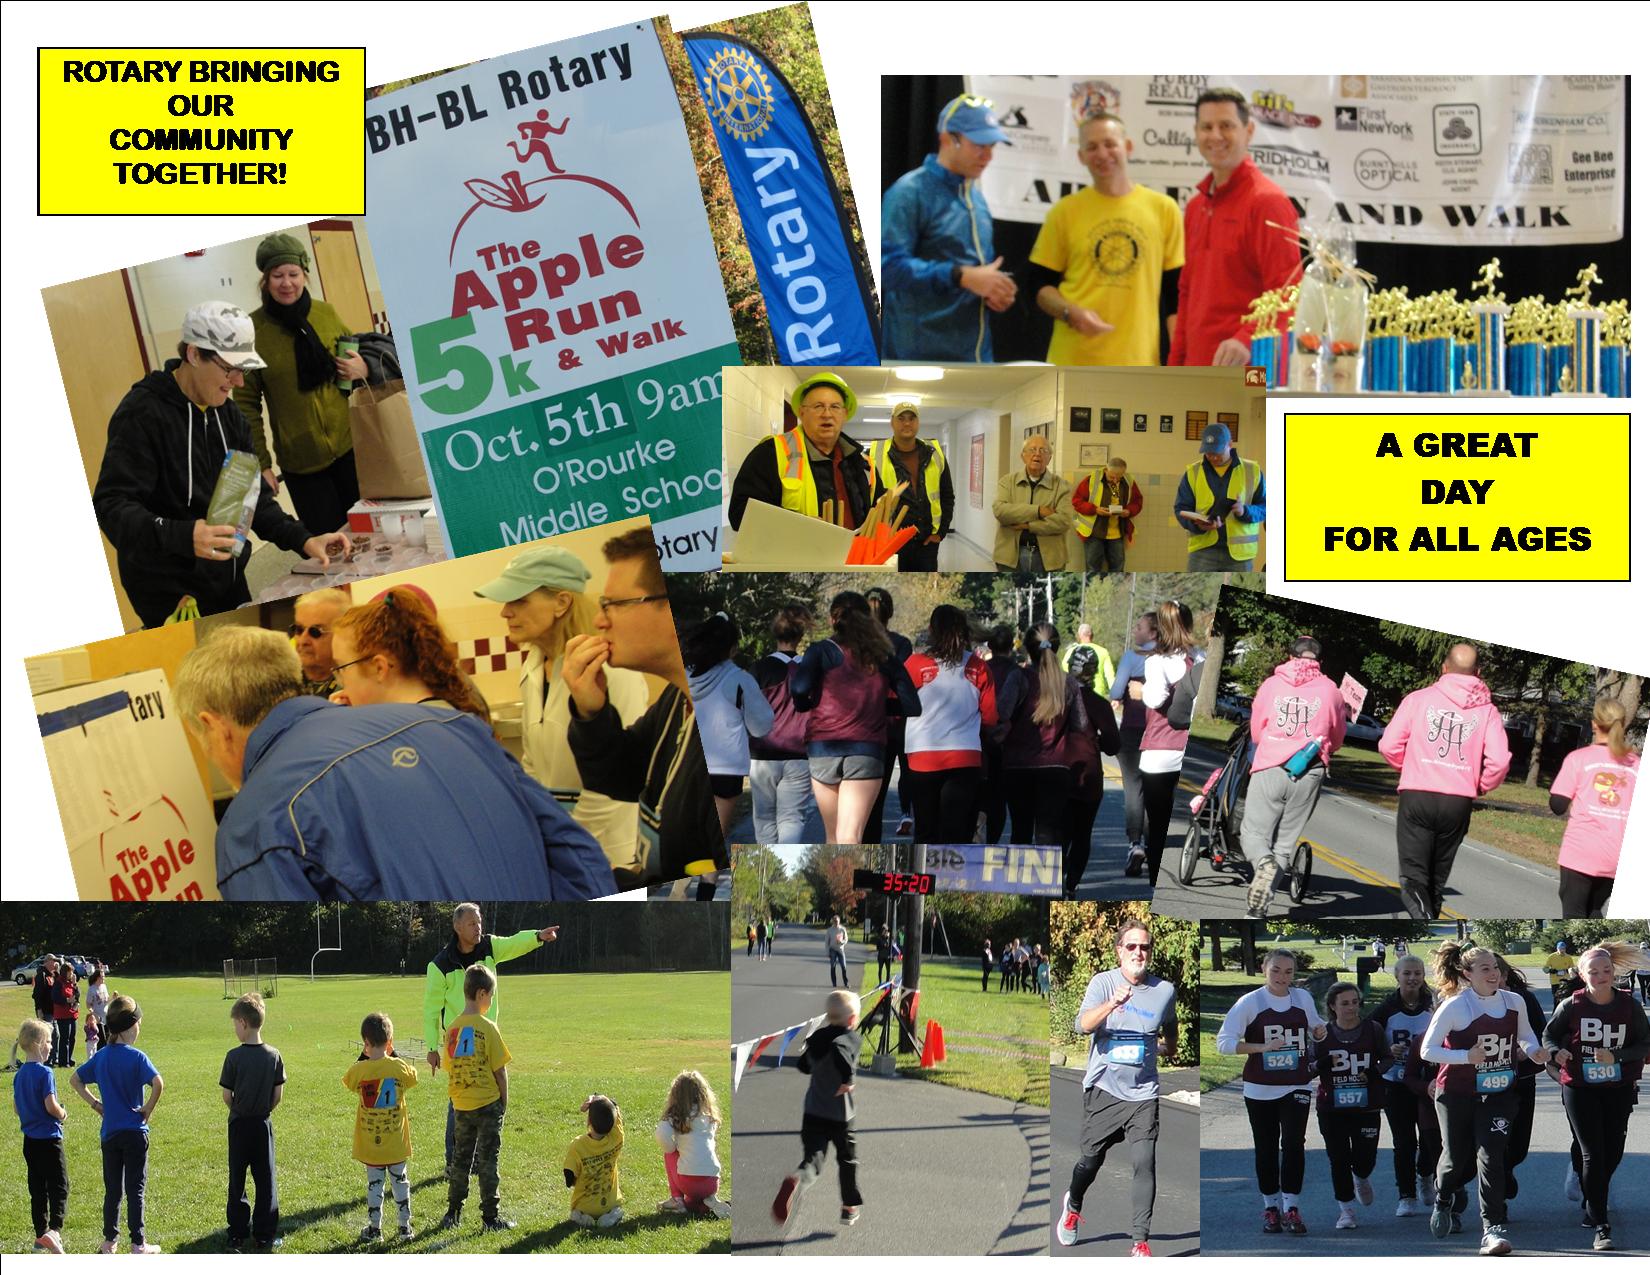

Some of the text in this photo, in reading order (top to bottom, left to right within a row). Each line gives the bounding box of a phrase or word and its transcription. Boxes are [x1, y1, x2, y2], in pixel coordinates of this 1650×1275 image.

[366, 43, 632, 154] BH-BL Rotary
[1359, 107, 1387, 121] First
[1254, 150, 1330, 174] RIDHOLM
[1360, 169, 1421, 182] OPTICAL
[1327, 202, 1423, 226] AND
[1441, 204, 1571, 228] WALK
[476, 240, 541, 271] The
[744, 147, 841, 363] Rotary
[451, 233, 645, 320] Apple
[504, 290, 643, 352] Run
[558, 318, 687, 371] & Walk
[445, 425, 541, 472] Oct.
[544, 392, 629, 447] 5th
[533, 439, 676, 494] O'Rourke
[499, 468, 722, 548] Middle Schoo
[127, 690, 167, 722] tary
[109, 838, 196, 901] Apple
[116, 845, 149, 873] The
[982, 846, 1063, 886] FIN
[463, 1038, 469, 1053] 1
[1263, 1024, 1306, 1051] BH
[1580, 1017, 1627, 1048] BH
[1267, 1055, 1294, 1068] 524
[1588, 1065, 1616, 1080] 530
[384, 1090, 390, 1105] 1
[1482, 1075, 1510, 1089] 499
[1338, 1091, 1363, 1105] 557
